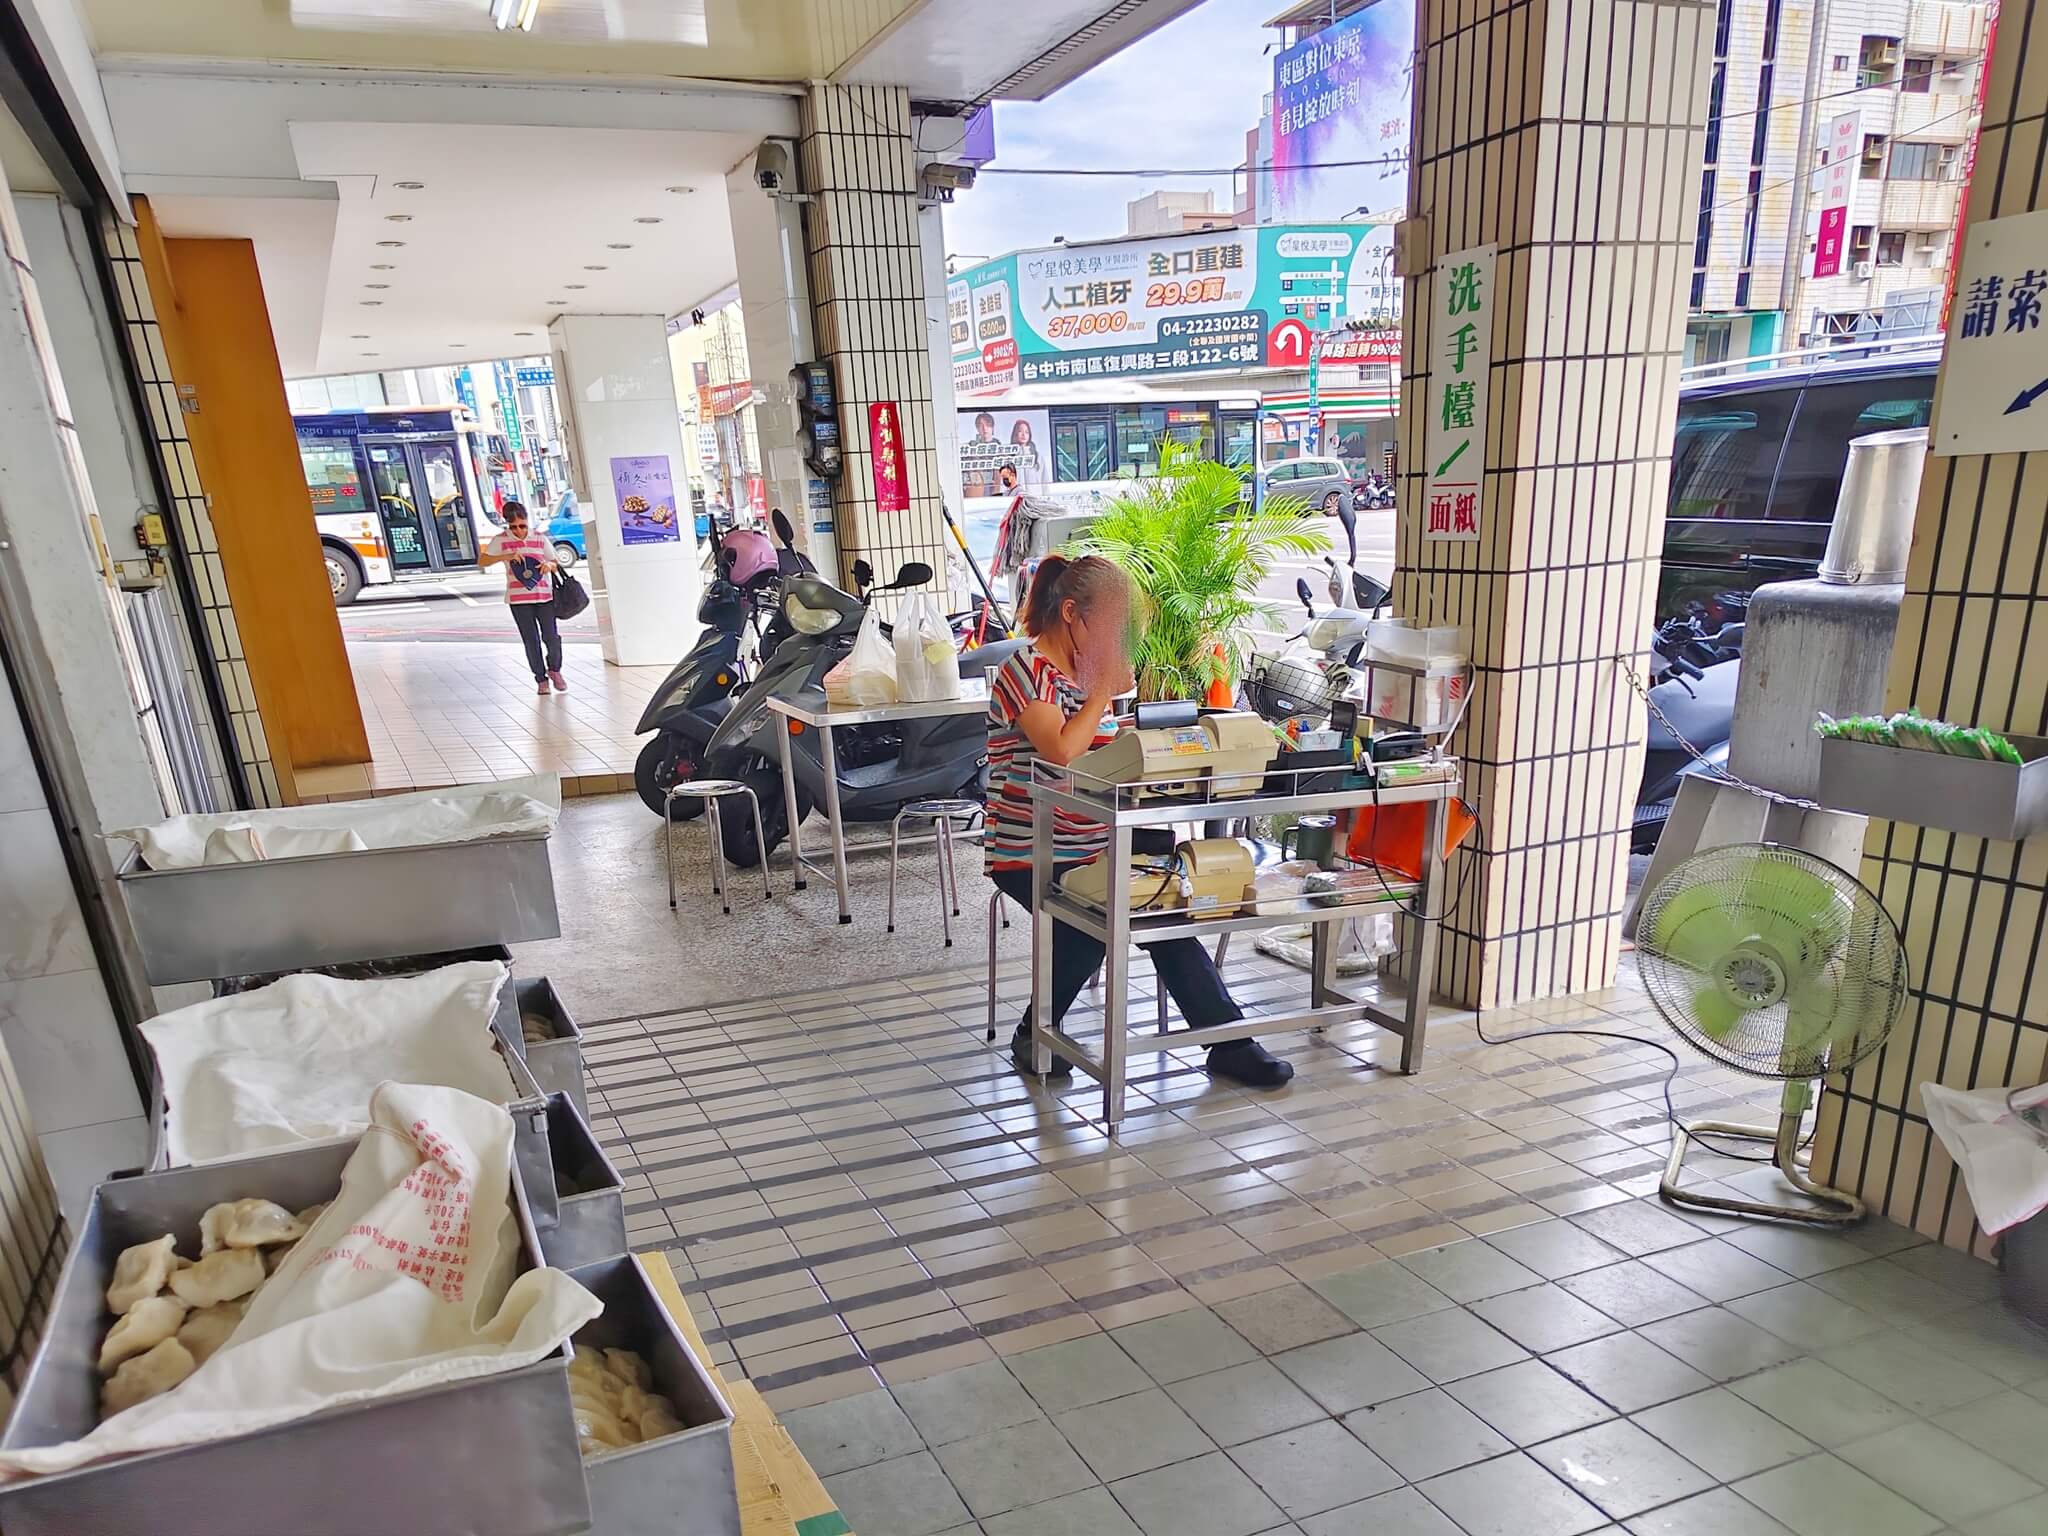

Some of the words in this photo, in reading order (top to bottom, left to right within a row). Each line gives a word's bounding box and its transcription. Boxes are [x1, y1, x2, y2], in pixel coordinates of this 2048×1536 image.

[1279, 28, 1361, 89] 東區對位東京
[1279, 77, 1361, 136] 看見綻放時刻
[1045, 257, 1102, 278] 星悅美學
[1148, 244, 1243, 277] 全口重建
[1042, 280, 1132, 312] 人工植牙
[1146, 277, 1225, 308] 29.9萬
[1960, 269, 2048, 340] 請索
[1048, 311, 1127, 338] 37,000
[1162, 314, 1259, 337] 04-22230282
[1023, 343, 1259, 379] 台中市南區復興路三段122-6號
[1441, 262, 1482, 432] 洗手檯
[1428, 492, 1477, 534] 面紙
